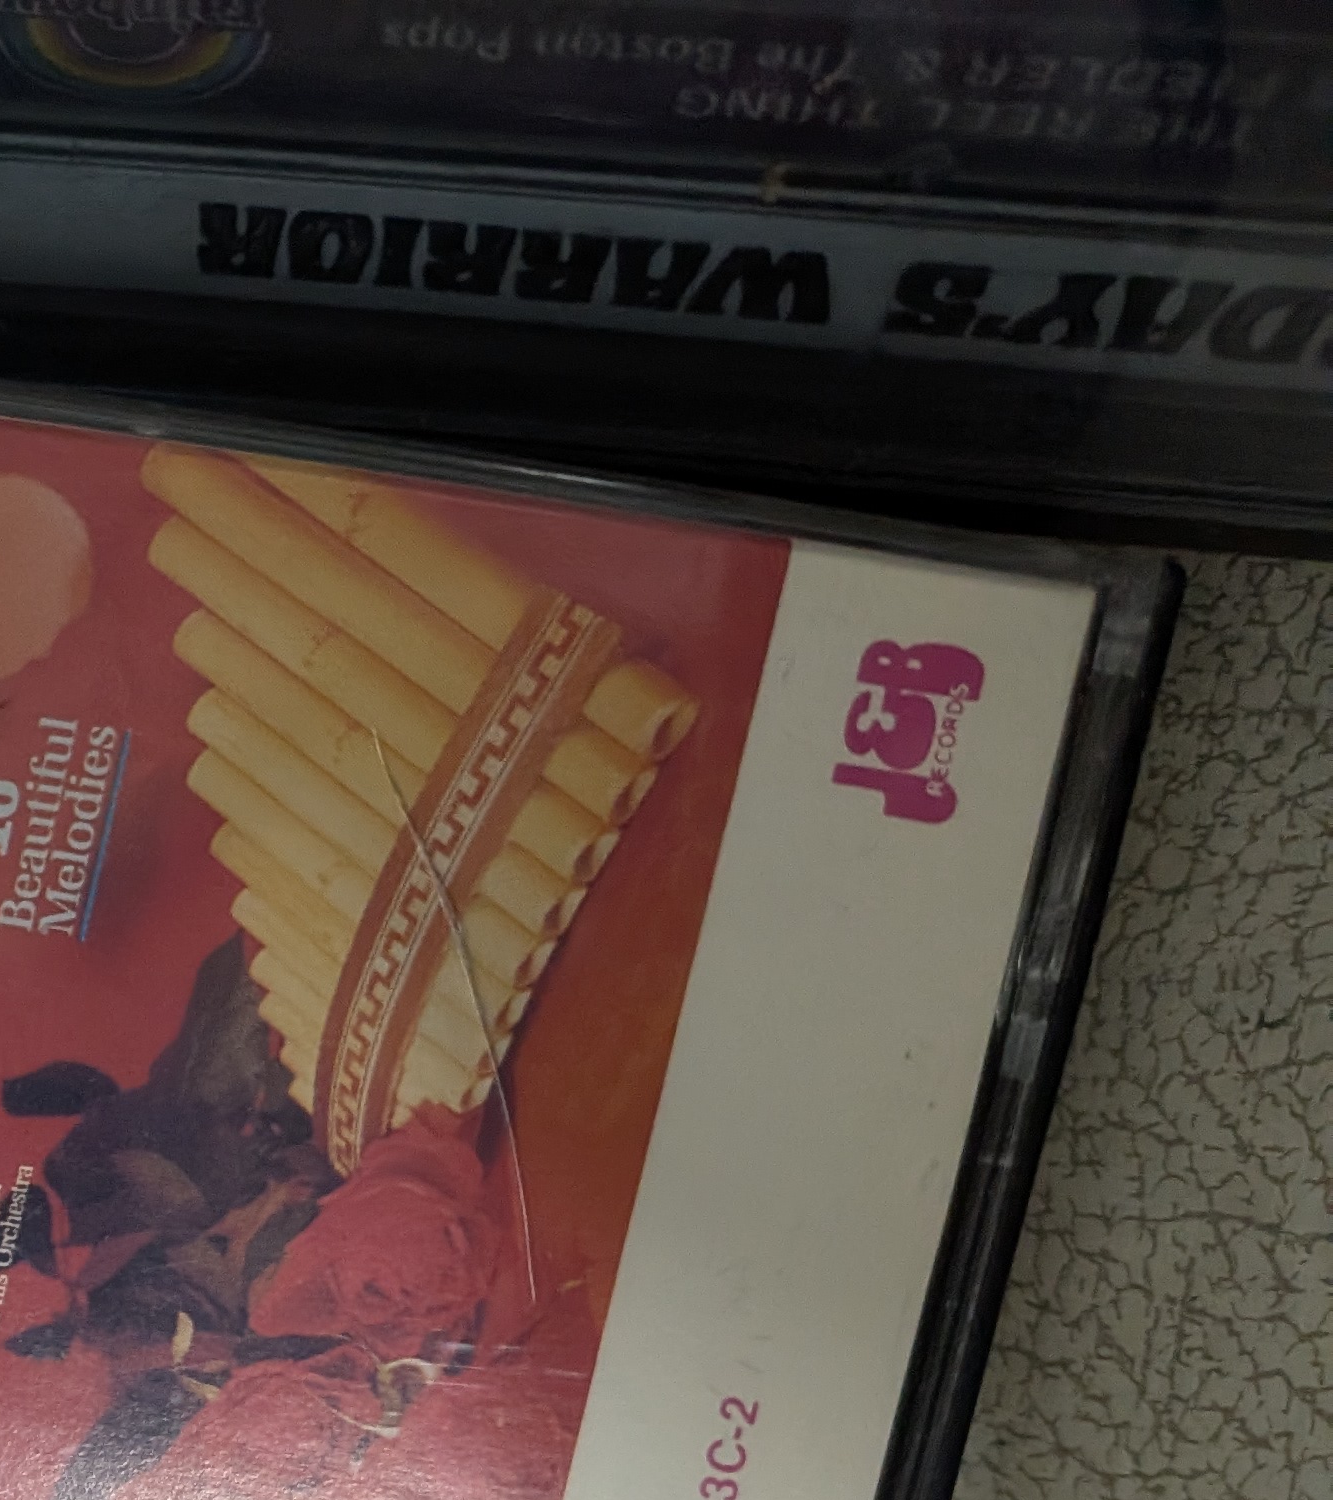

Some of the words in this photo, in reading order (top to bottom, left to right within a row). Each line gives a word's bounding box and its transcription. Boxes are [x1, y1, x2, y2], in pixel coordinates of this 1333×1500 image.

[902, 45, 941, 79] &
[192, 202, 830, 324] WARRIOR
[923, 678, 974, 799] RECORDS
[36, 718, 122, 939] Melodies
